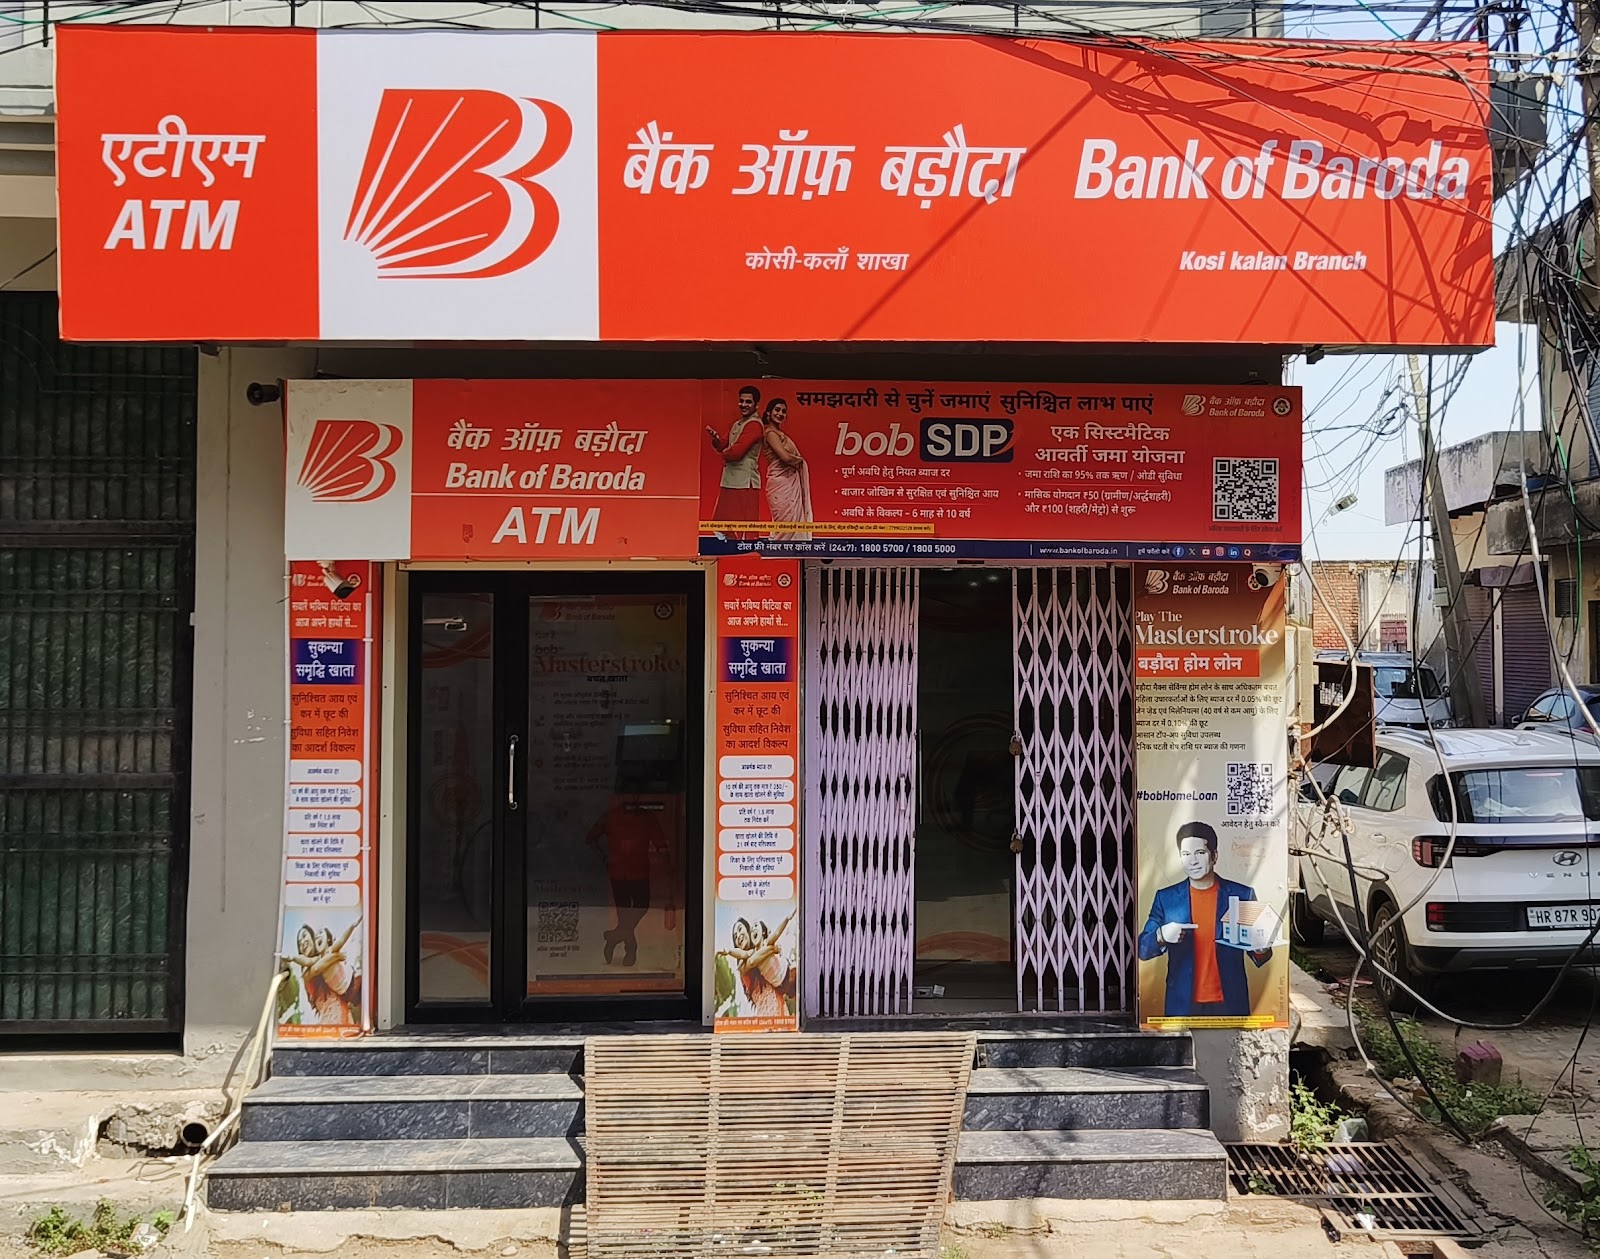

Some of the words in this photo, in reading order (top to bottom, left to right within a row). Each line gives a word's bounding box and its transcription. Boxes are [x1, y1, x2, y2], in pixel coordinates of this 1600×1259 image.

[101, 115, 266, 187] एटीएम
[624, 120, 714, 194] बैंक
[732, 130, 855, 200] ऑफ़
[881, 124, 1027, 209] बड़ौदा
[1074, 139, 1214, 198] Bank
[1221, 140, 1277, 199] of
[1283, 139, 1470, 200] Baroda
[104, 200, 240, 249] ATM
[746, 246, 849, 270] कोसी-कलाँ
[857, 254, 909, 270] शाखा
[1180, 251, 1225, 270] Kosi
[1230, 251, 1287, 270] kalan
[1293, 251, 1367, 270] Branch
[796, 387, 879, 409] समझदारी
[884, 387, 901, 407] से
[906, 389, 934, 414] चुनें
[940, 390, 991, 412] जमाएं
[1000, 389, 1072, 415] सुनिश्चित
[1077, 396, 1116, 411] लाभ
[1121, 393, 1154, 415] पाएं
[1209, 408, 1228, 416] Bank
[448, 419, 492, 449] बैंक
[501, 423, 563, 452] ऑफ़
[575, 421, 648, 456] बड़ौदा
[835, 423, 914, 456] bob
[927, 424, 1007, 456] SDP
[1051, 427, 1079, 442] एक
[1084, 422, 1170, 440] सिस्टमैटिक
[1035, 445, 1088, 462] आवर्ती
[1092, 450, 1128, 462] जमा
[1132, 446, 1185, 463] योजना
[446, 463, 516, 488] Bank
[520, 464, 548, 488] of
[550, 464, 645, 490] Baroda
[492, 507, 600, 544] ATM
[737, 541, 752, 551] टोल
[754, 541, 764, 551] फ्री
[795, 541, 812, 551] कॉल
[814, 542, 825, 551] करें
[861, 543, 880, 552] 1800
[883, 543, 904, 552] 5700
[913, 545, 932, 553] 1800
[935, 544, 955, 553] 5000
[1173, 585, 1192, 594] Bank
[1193, 585, 1201, 594] of
[1202, 585, 1229, 594] Baroda
[1158, 611, 1182, 621] The
[1136, 624, 1278, 645] Masterstroke
[308, 641, 344, 659] सुकन्या
[741, 640, 774, 657] सुकन्या
[296, 660, 325, 681] समृद्धि
[328, 664, 355, 677] खाता
[728, 658, 758, 678] समृद्धि
[761, 663, 786, 674] खाता
[1138, 653, 1179, 674] बड़ौदा
[1184, 653, 1210, 672] होम
[1213, 653, 1242, 670] लोन
[1137, 791, 1218, 801] #bobHomeLoan
